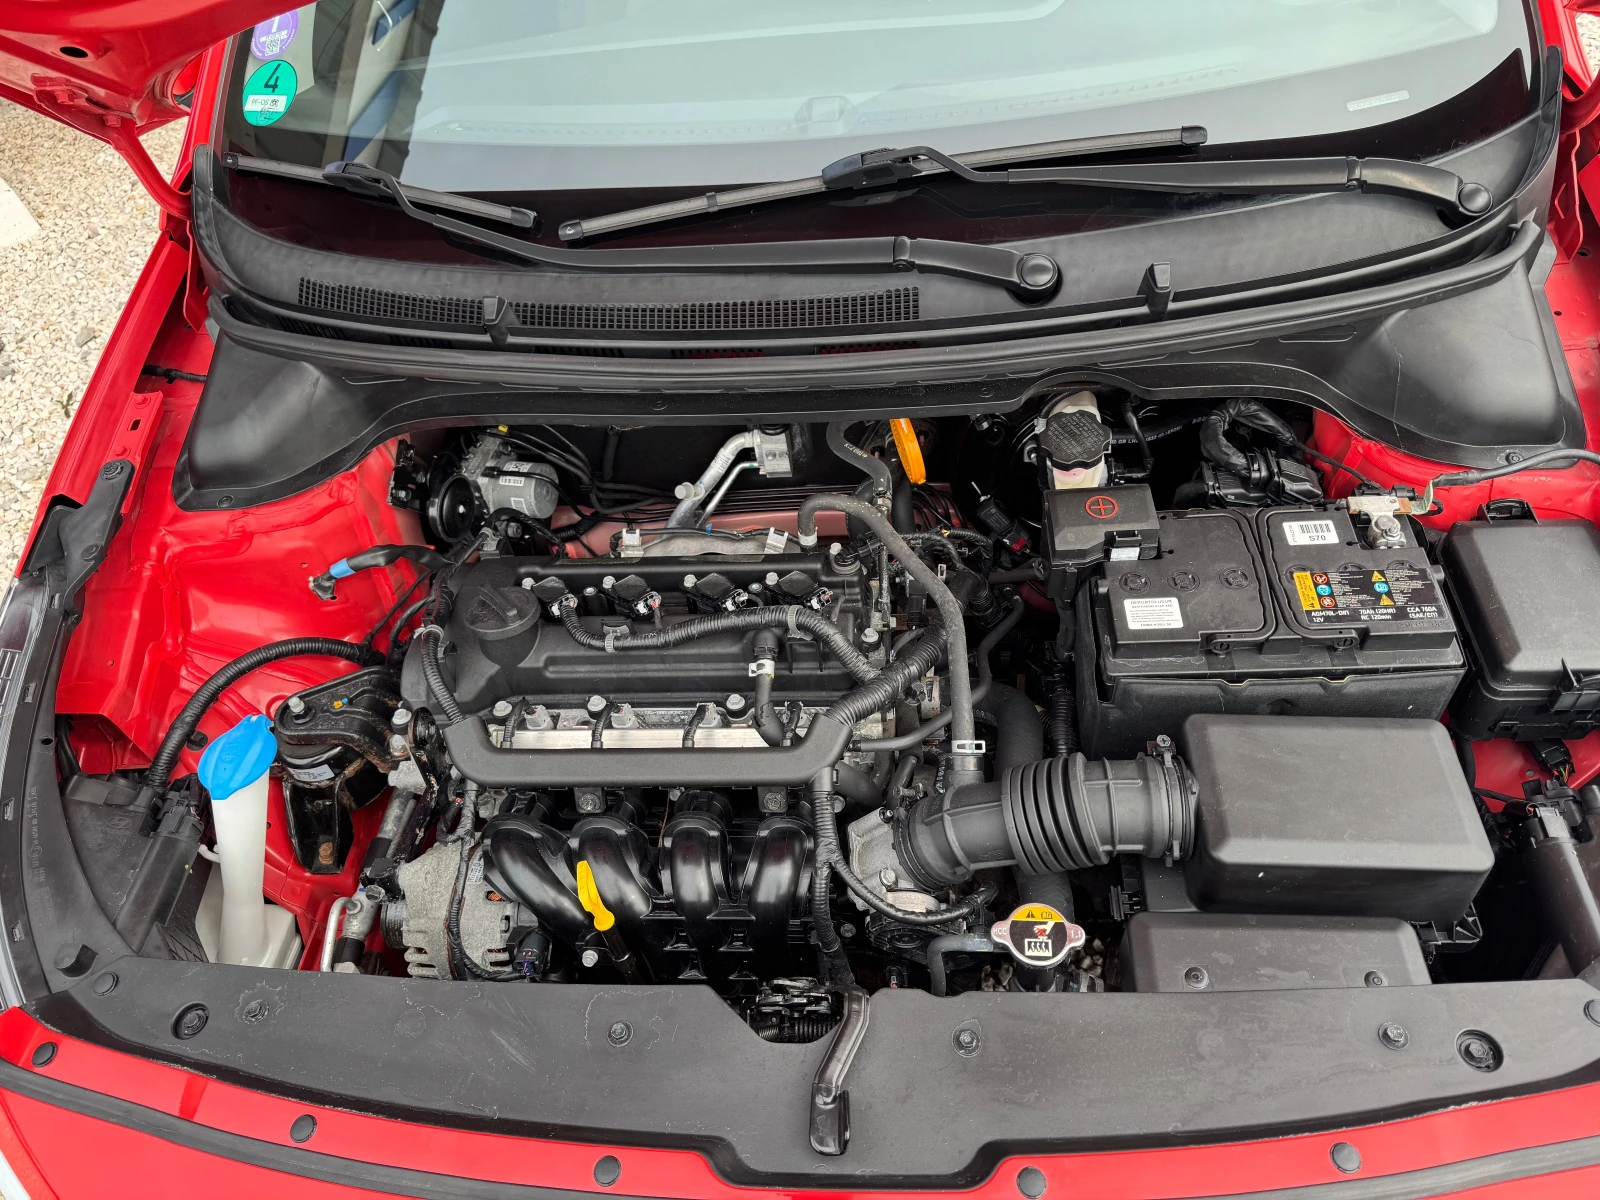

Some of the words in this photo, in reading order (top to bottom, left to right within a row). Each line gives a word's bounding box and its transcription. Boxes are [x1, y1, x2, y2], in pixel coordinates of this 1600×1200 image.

[263, 63, 282, 93] 4
[1308, 534, 1327, 542] S70
[993, 927, 1008, 935] HCC
[1070, 930, 1082, 938] 1.1
